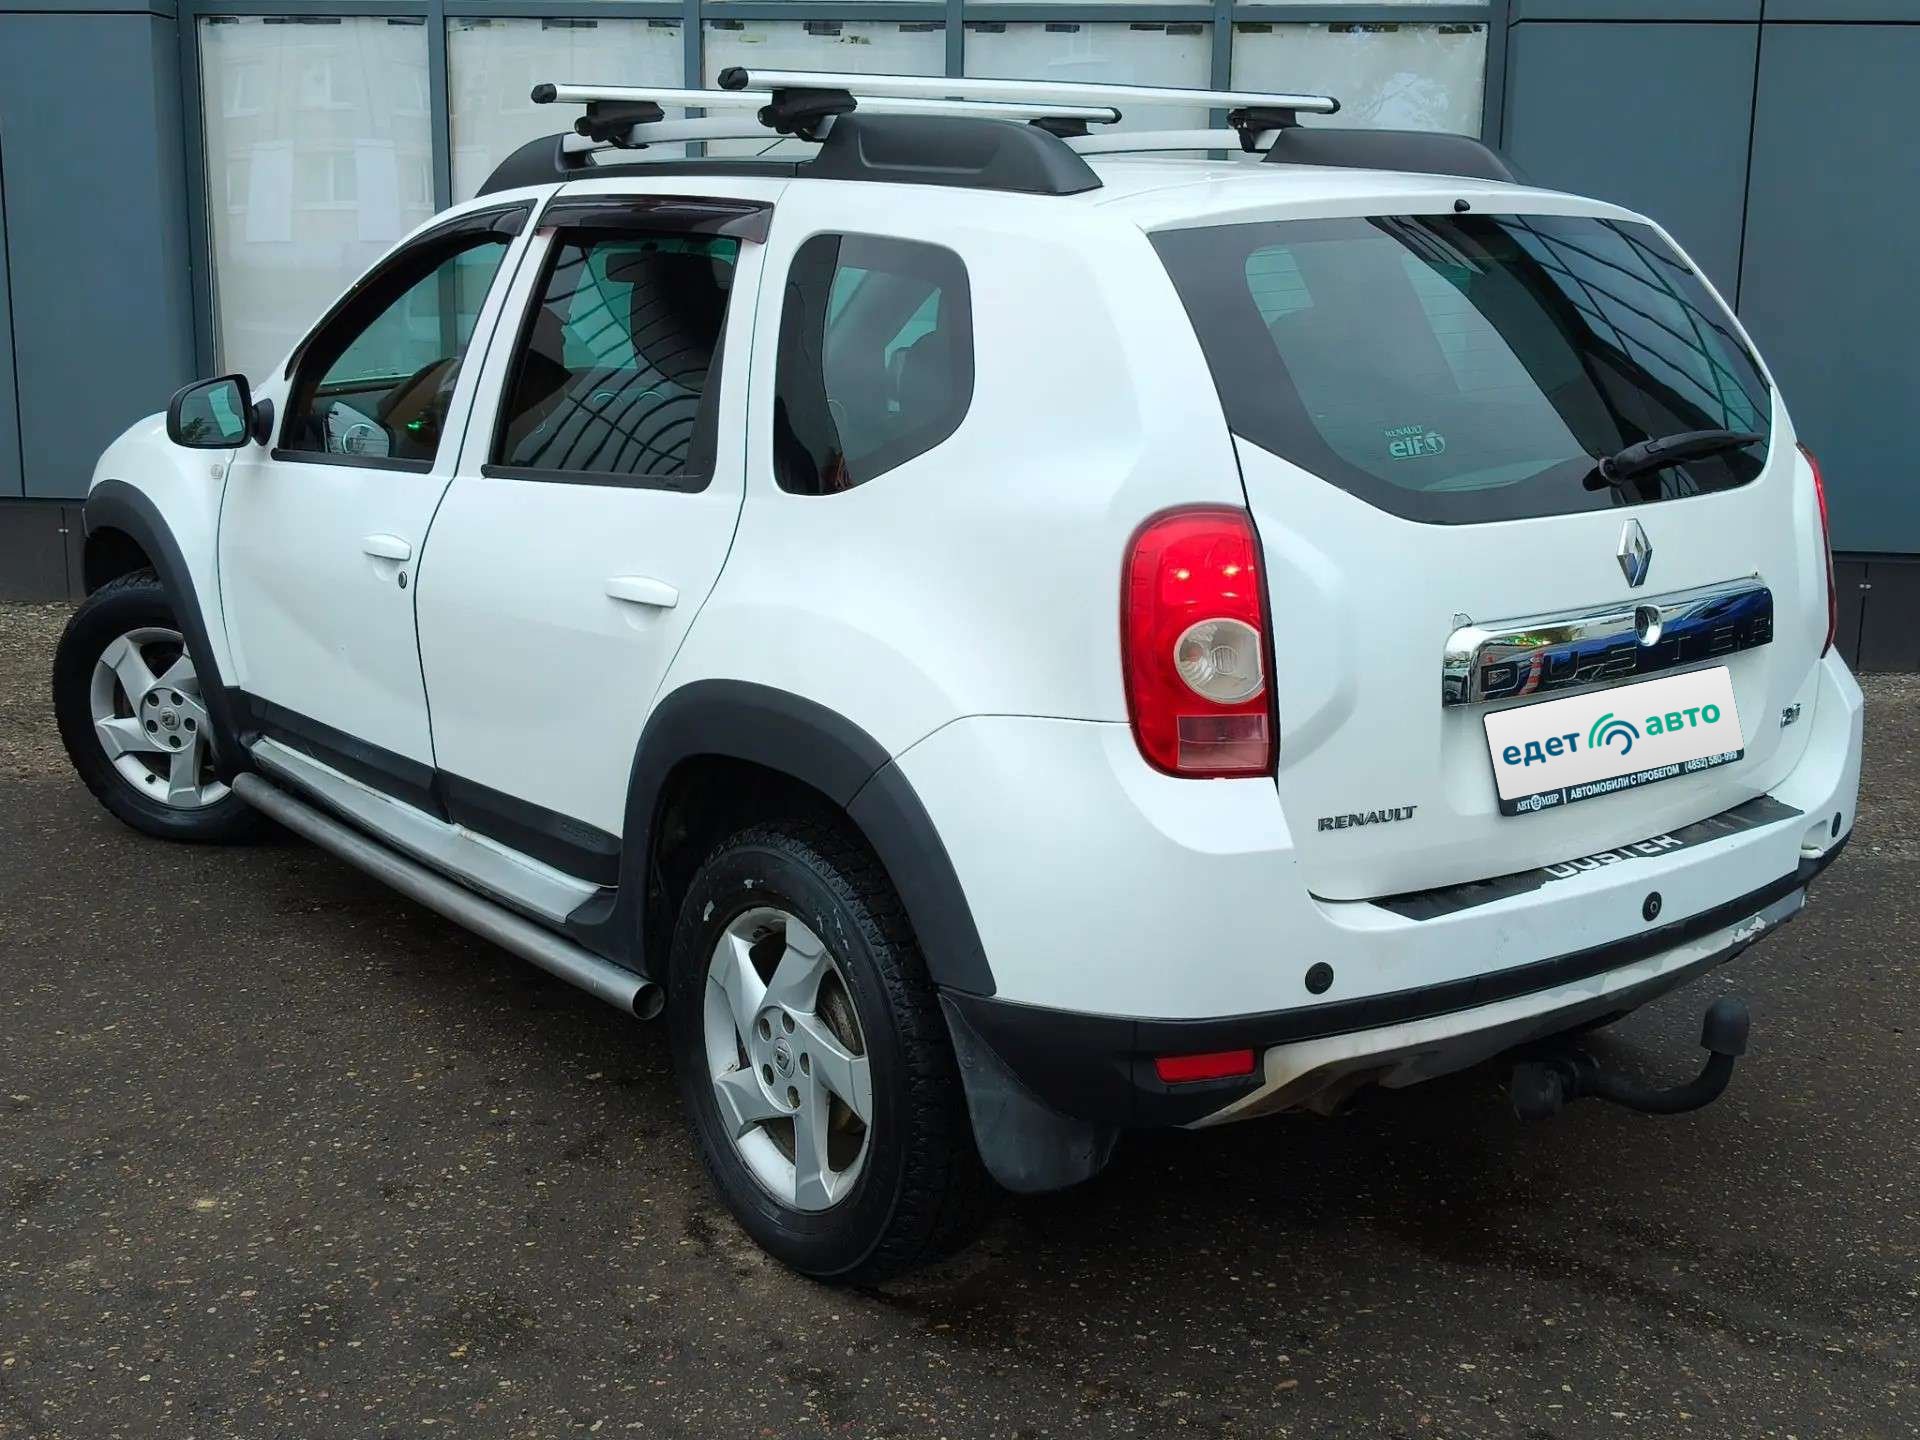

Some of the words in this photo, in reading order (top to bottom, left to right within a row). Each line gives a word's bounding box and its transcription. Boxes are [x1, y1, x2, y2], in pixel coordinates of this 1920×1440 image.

[1570, 775, 1629, 800] АВТОМОБИЛИ
[1637, 763, 1680, 783] ПРОБЕГОМ
[1317, 805, 1418, 832] RENAULT
